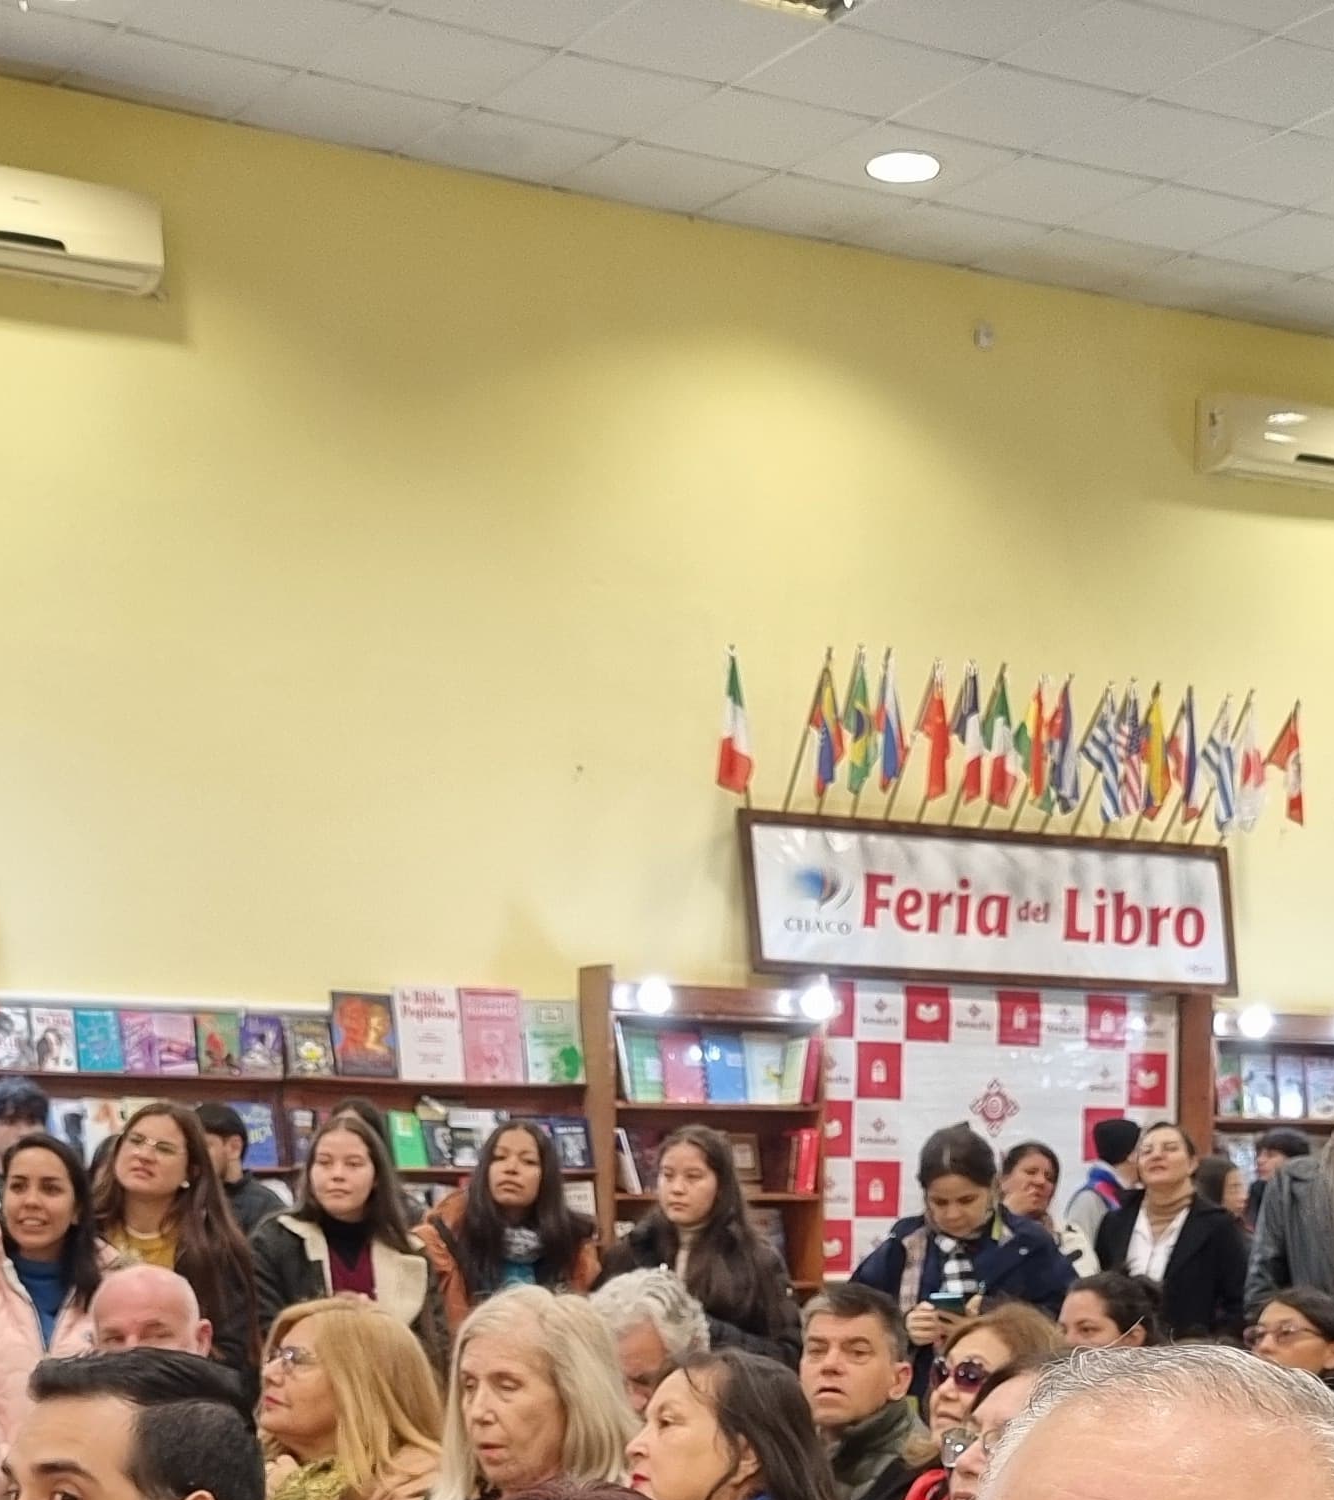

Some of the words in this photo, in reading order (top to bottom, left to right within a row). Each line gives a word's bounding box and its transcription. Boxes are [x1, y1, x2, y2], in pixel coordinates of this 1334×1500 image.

[863, 872, 1010, 938] Feria
[1018, 901, 1050, 924] del
[1063, 887, 1205, 948] Libro
